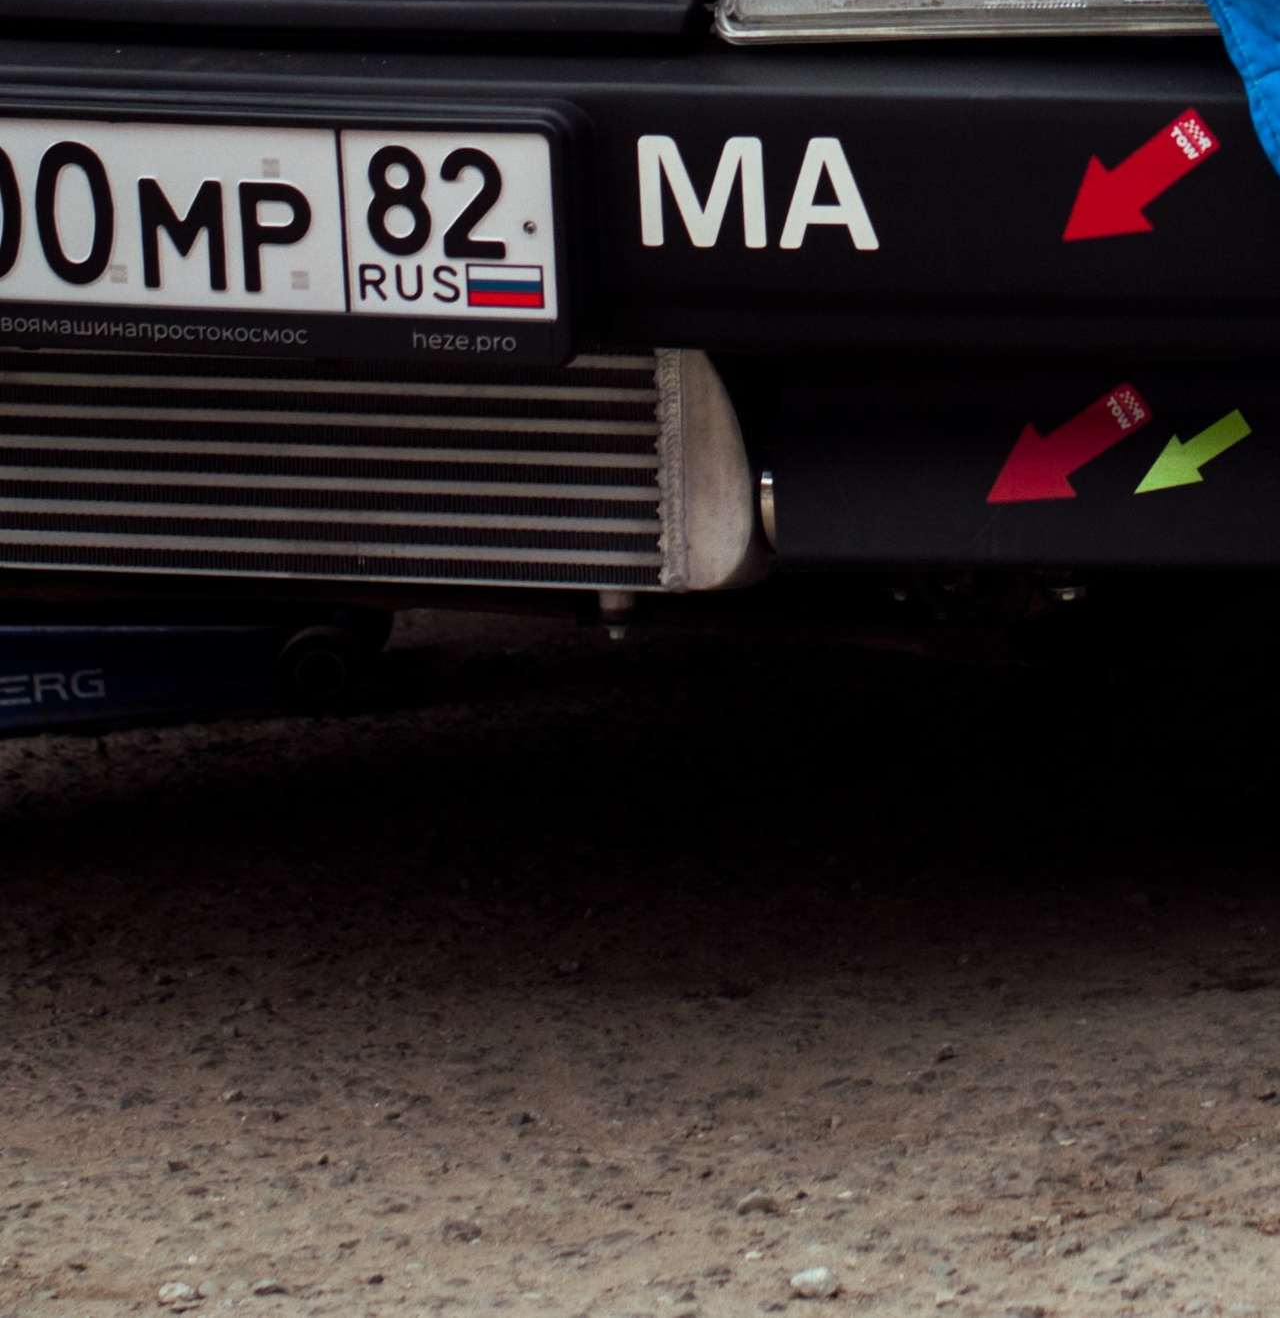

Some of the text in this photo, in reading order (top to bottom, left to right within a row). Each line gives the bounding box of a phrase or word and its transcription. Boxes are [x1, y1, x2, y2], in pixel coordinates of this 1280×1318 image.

[1169, 125, 1200, 161] TOW
[366, 144, 507, 260] 82
[637, 134, 880, 251] MA
[358, 263, 461, 303] RUS
[412, 328, 518, 353] heze.pro
[1106, 395, 1132, 431] TOW
